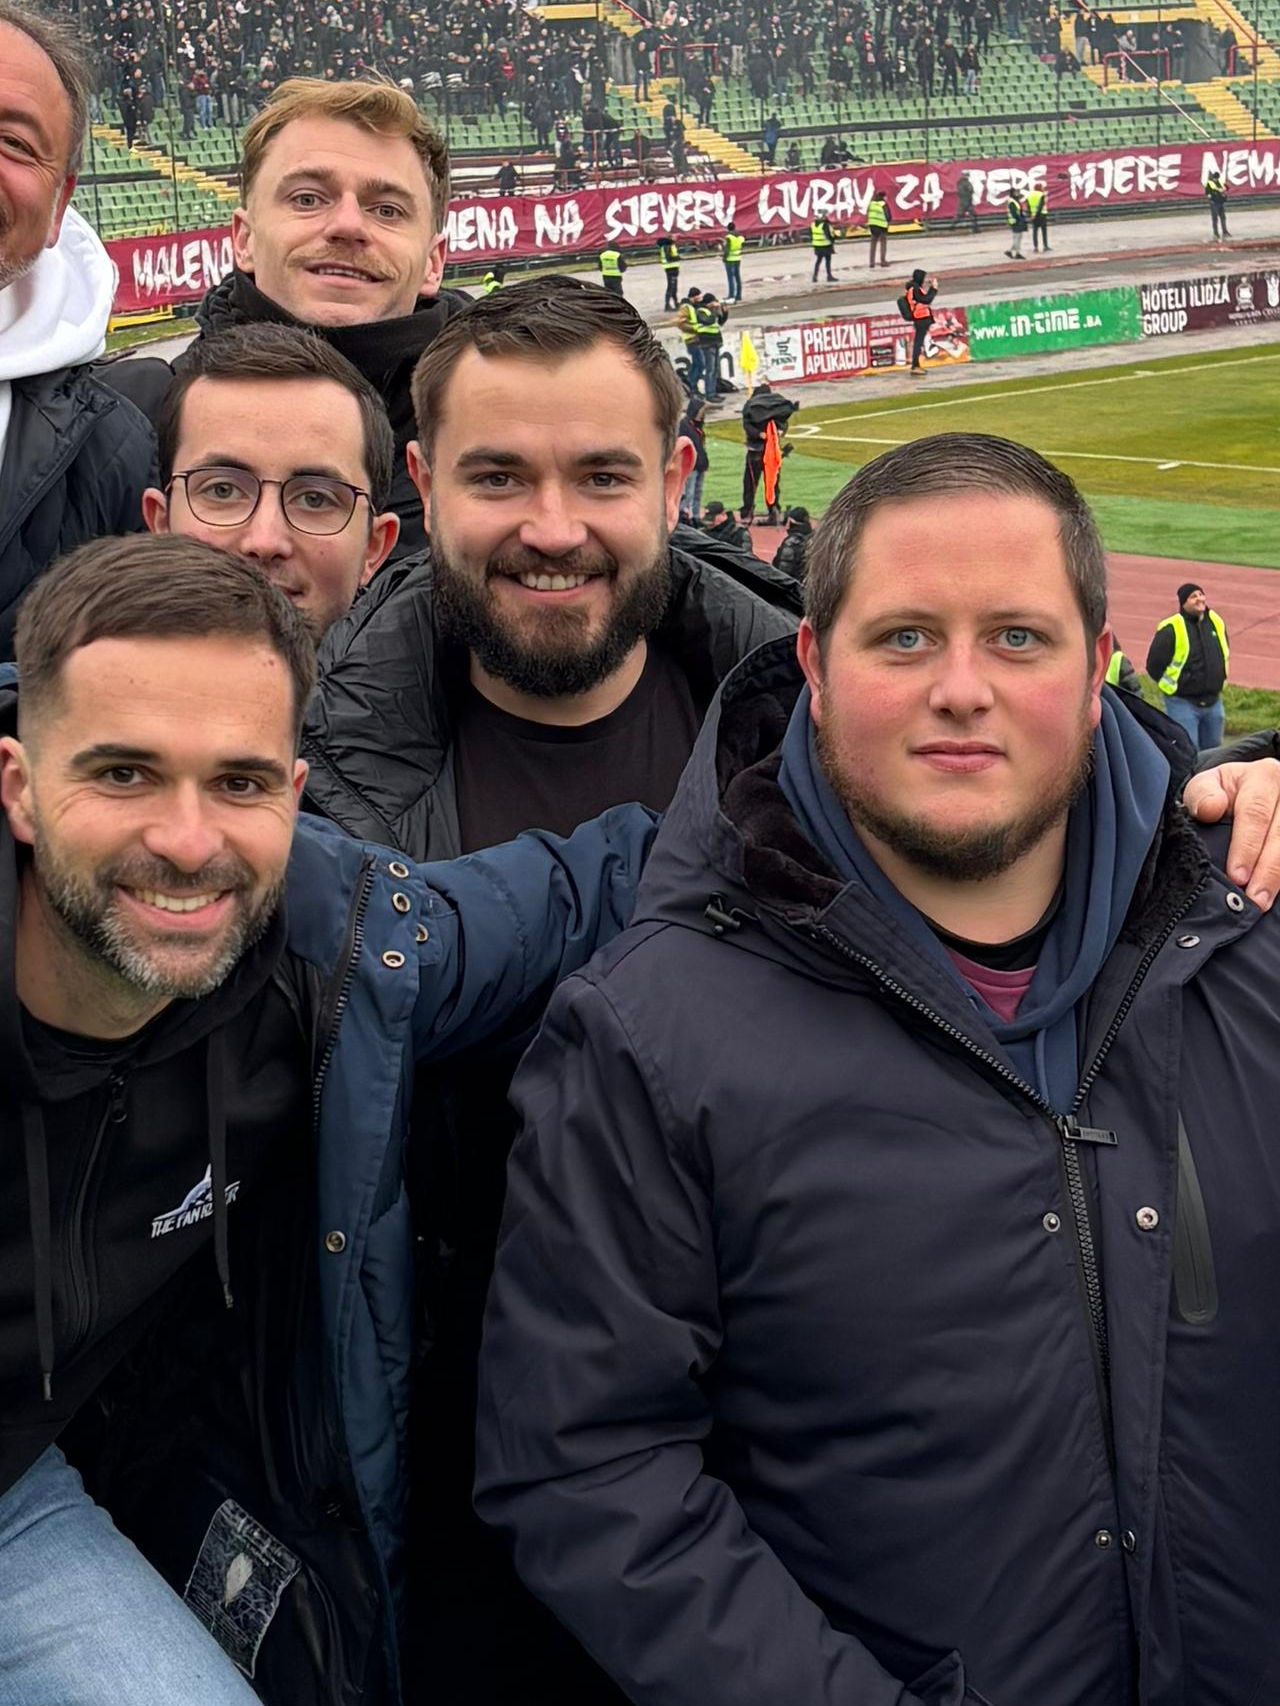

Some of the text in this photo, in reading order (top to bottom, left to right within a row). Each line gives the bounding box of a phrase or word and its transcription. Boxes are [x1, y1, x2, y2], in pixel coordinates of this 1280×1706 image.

[534, 199, 584, 248] NA
[604, 190, 736, 241] SJEVERU
[895, 173, 944, 212] ZA
[1141, 287, 1186, 312] HOTELI
[1143, 310, 1188, 334] GROUP
[803, 323, 867, 353] PREUZMI
